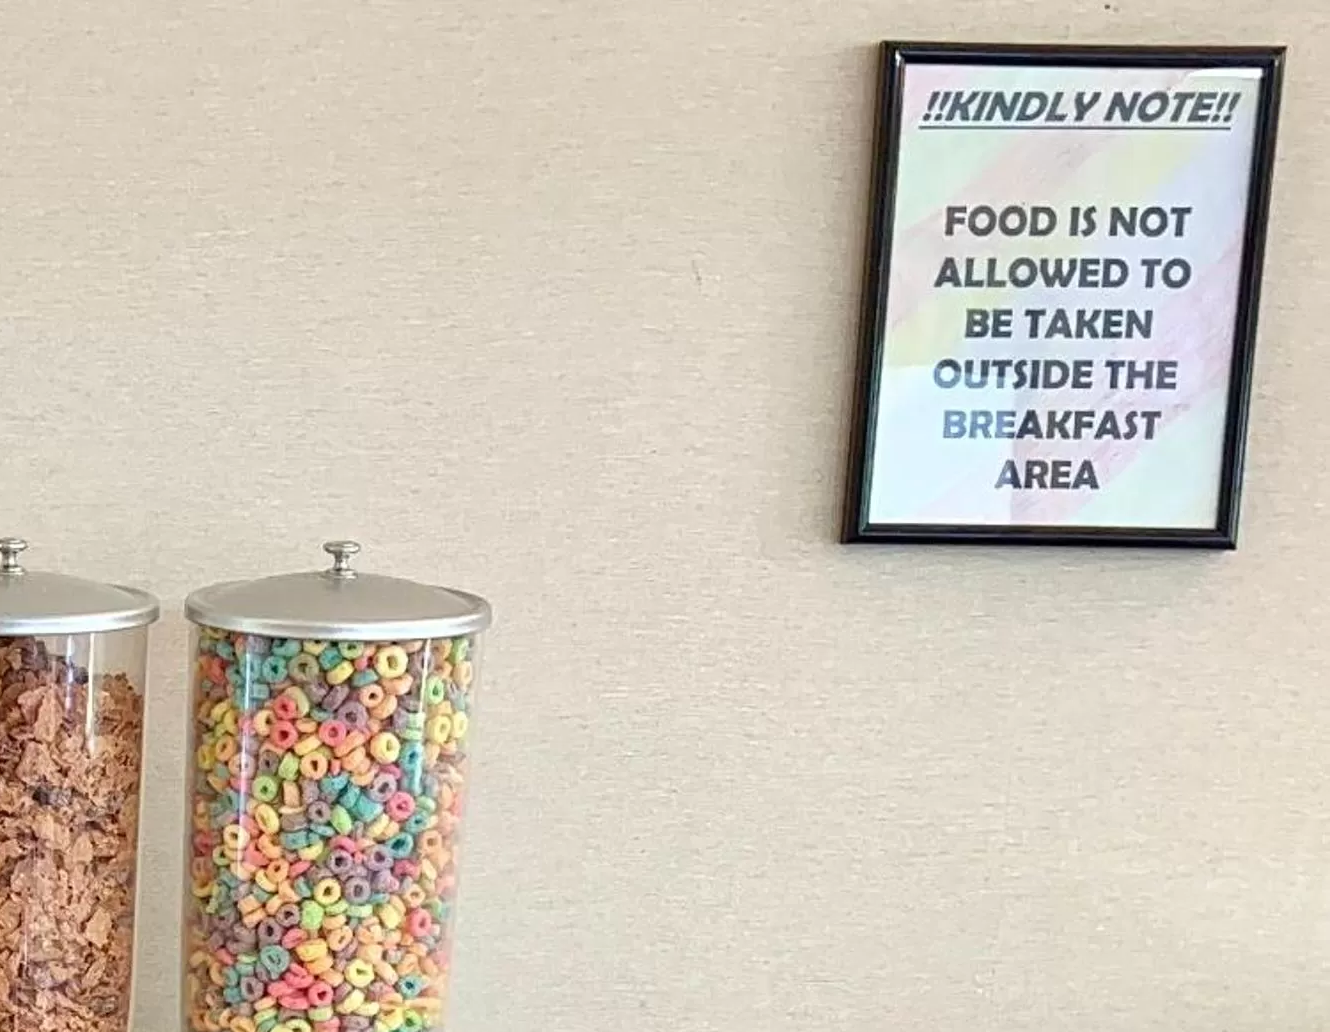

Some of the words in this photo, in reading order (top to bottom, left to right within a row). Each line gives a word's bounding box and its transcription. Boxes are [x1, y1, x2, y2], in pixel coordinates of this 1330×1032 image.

[922, 90, 1107, 123] !!KINDLY
[1105, 90, 1241, 123] NOTE!!
[944, 205, 1058, 237] FOOD
[1069, 205, 1097, 237] IS
[1108, 205, 1193, 237] NOT
[933, 257, 1129, 288] ALLOWED
[1141, 258, 1192, 288] TO
[964, 308, 1014, 338] BE
[1024, 308, 1154, 339] TAKEN
[932, 358, 1094, 389] OUTSIDE
[1104, 360, 1179, 389] THE
[942, 409, 1162, 440] BREAKFAST
[994, 459, 1100, 489] AREA
